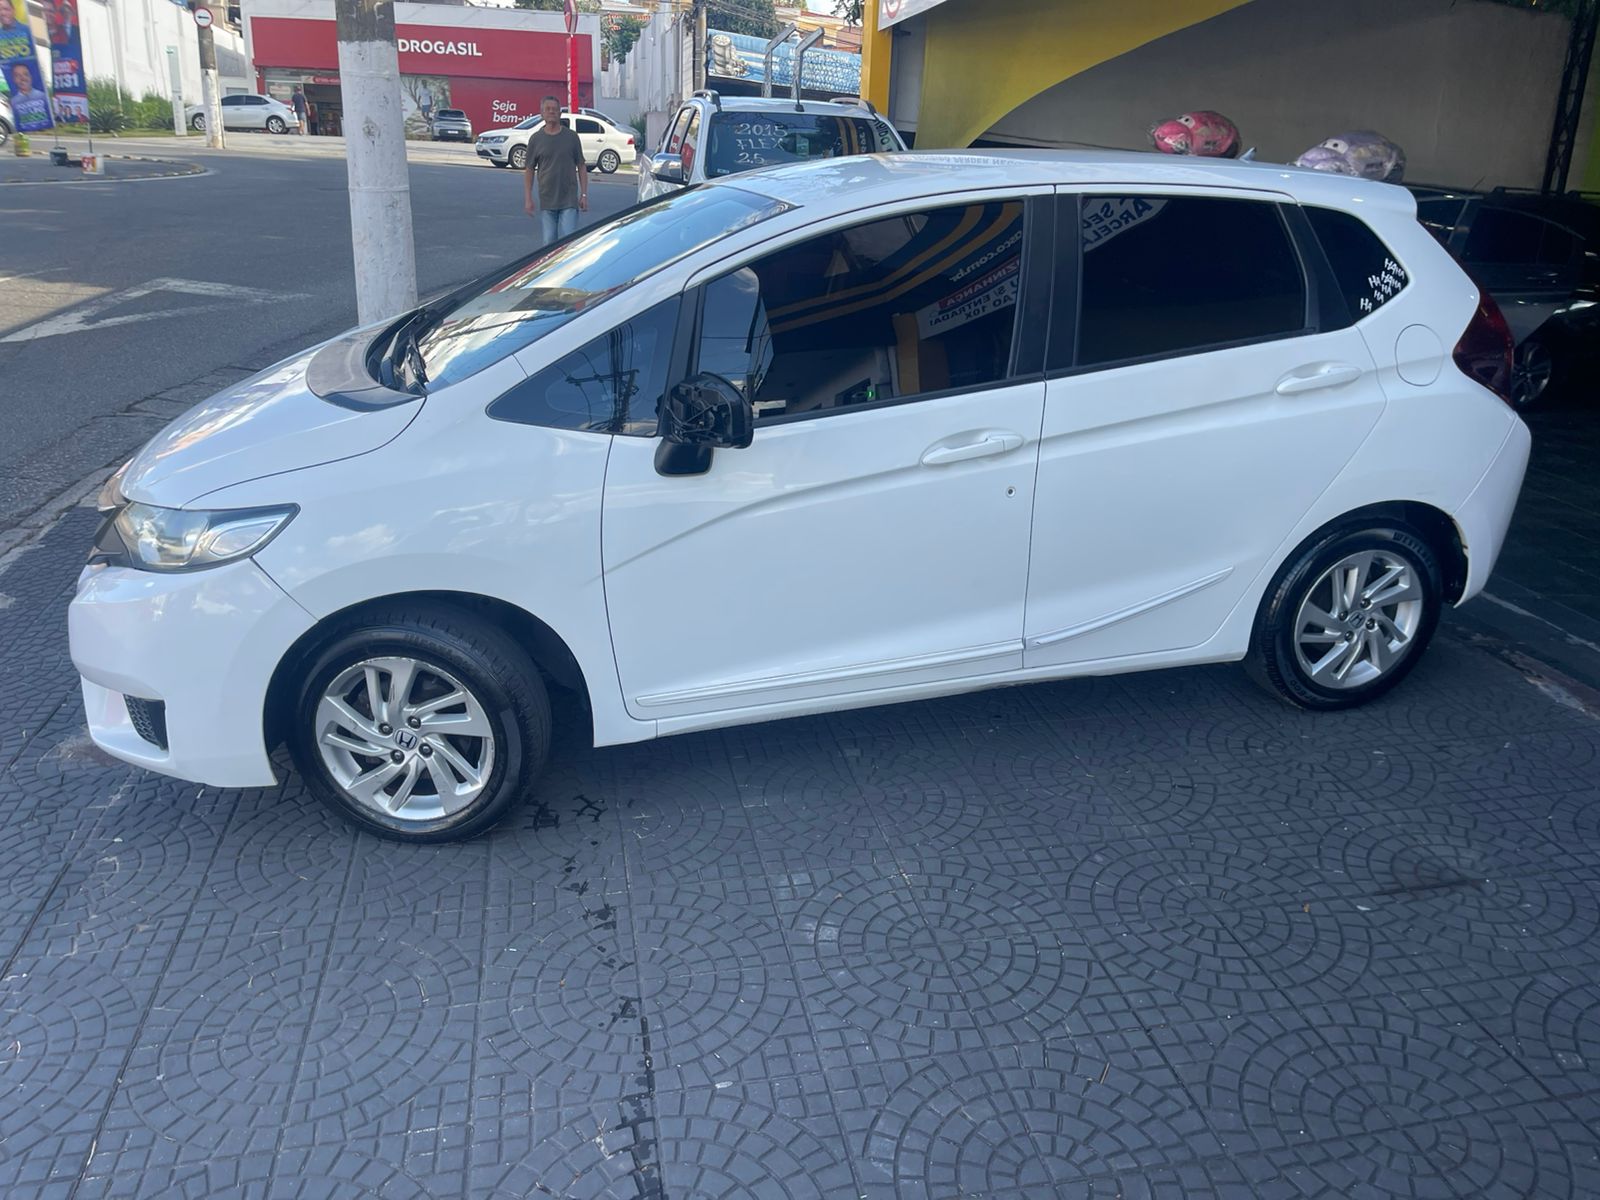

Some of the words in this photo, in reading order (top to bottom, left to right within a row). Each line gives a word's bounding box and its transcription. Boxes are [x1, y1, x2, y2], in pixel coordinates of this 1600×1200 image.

[398, 39, 482, 56] DROGASIL
[492, 99, 517, 113] Seja
[735, 123, 788, 137] 2015
[736, 138, 784, 151] FLEX
[735, 152, 765, 165] 2.5
